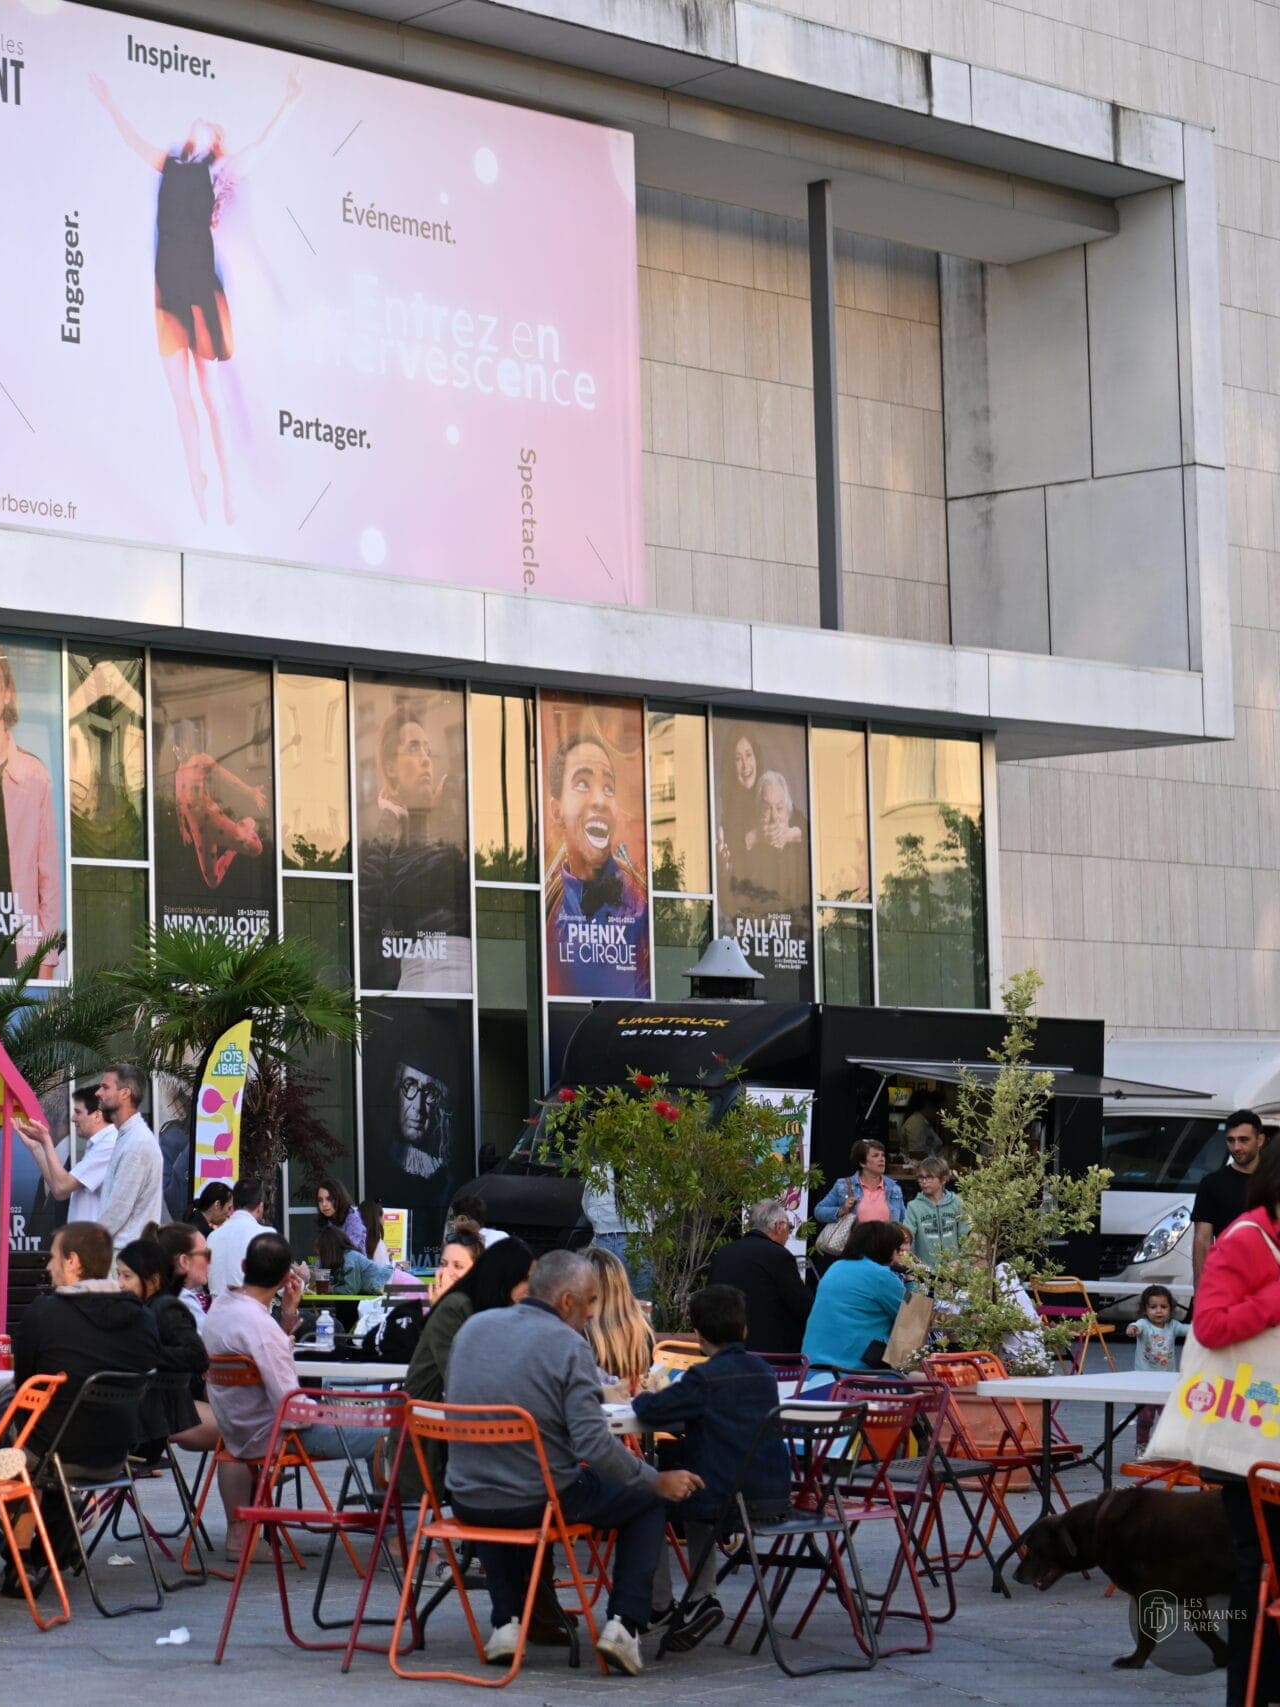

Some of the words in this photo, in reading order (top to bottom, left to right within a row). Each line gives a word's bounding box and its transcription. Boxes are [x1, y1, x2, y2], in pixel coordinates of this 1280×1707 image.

[126, 34, 216, 79] Inspirer.
[341, 192, 457, 244] Événement.
[61, 210, 84, 344] Engager.
[352, 272, 499, 353] Entrez
[511, 320, 560, 363] en
[278, 411, 372, 451] Partager.
[517, 447, 540, 594] Spectacle.
[382, 936, 447, 960] SUZANE
[568, 918, 627, 945] PHÉNIX
[736, 917, 792, 939] FALLAIT
[559, 942, 575, 963] LE
[579, 942, 637, 965] CIRQUE
[754, 938, 769, 957] LE
[773, 938, 806, 960] DIRE
